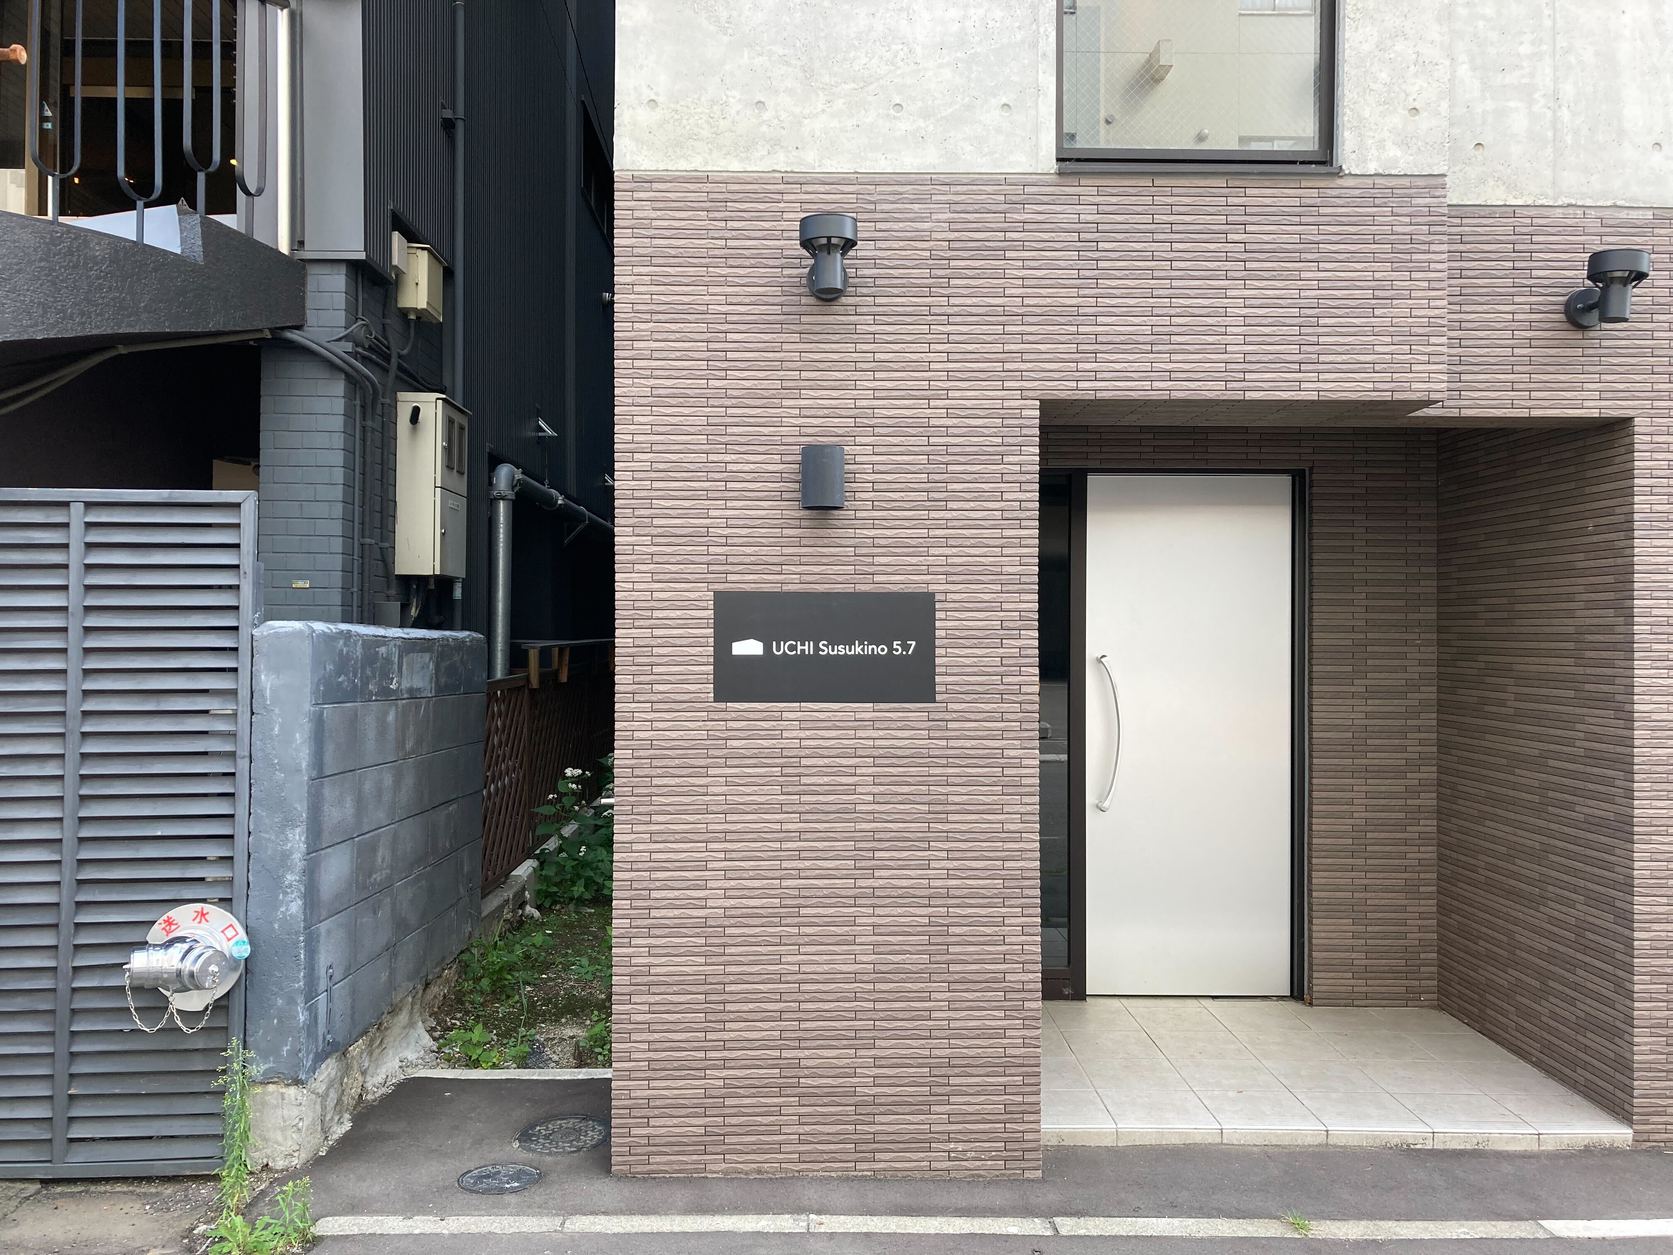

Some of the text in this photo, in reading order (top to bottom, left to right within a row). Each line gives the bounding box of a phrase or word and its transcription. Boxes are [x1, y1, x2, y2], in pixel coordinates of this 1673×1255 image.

[772, 640, 916, 655] UCHI Susukino 5.7
[158, 906, 239, 942] 送水口
